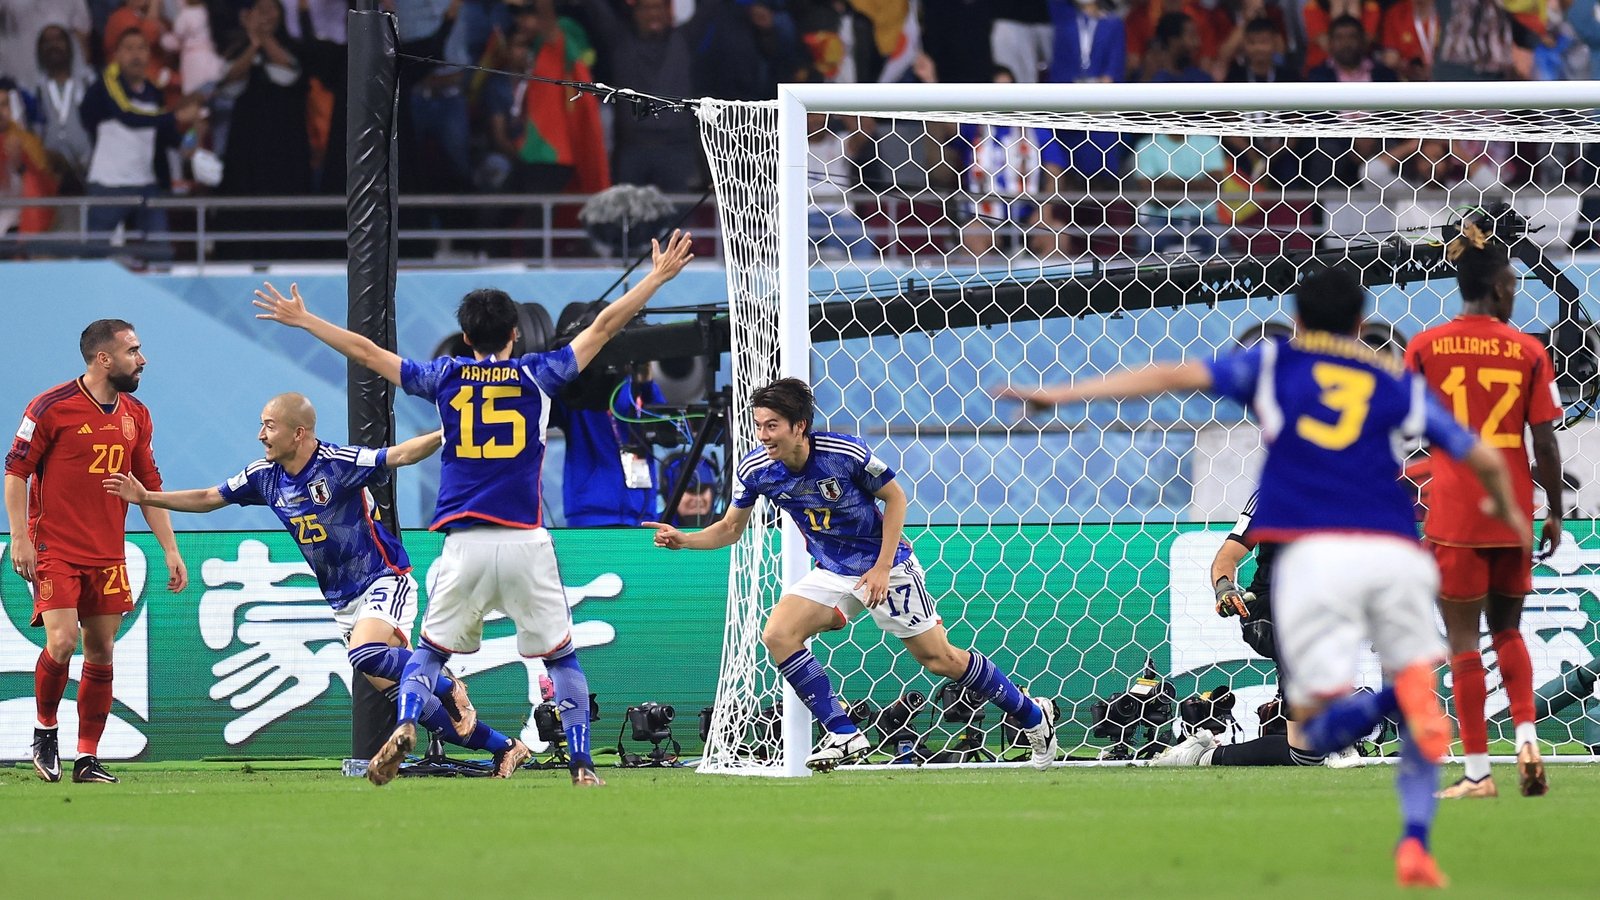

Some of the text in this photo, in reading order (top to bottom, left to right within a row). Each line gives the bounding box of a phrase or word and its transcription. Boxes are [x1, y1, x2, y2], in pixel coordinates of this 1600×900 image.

[1432, 336, 1500, 356] WILLIAMS
[461, 365, 520, 382] KAMADA
[1295, 360, 1377, 451] 3
[1440, 366, 1523, 448] 12
[449, 385, 526, 459] 15
[88, 444, 125, 473] 20
[289, 513, 328, 544] 25
[803, 507, 832, 531] 17
[102, 564, 131, 595] 20
[886, 583, 912, 617] 17
